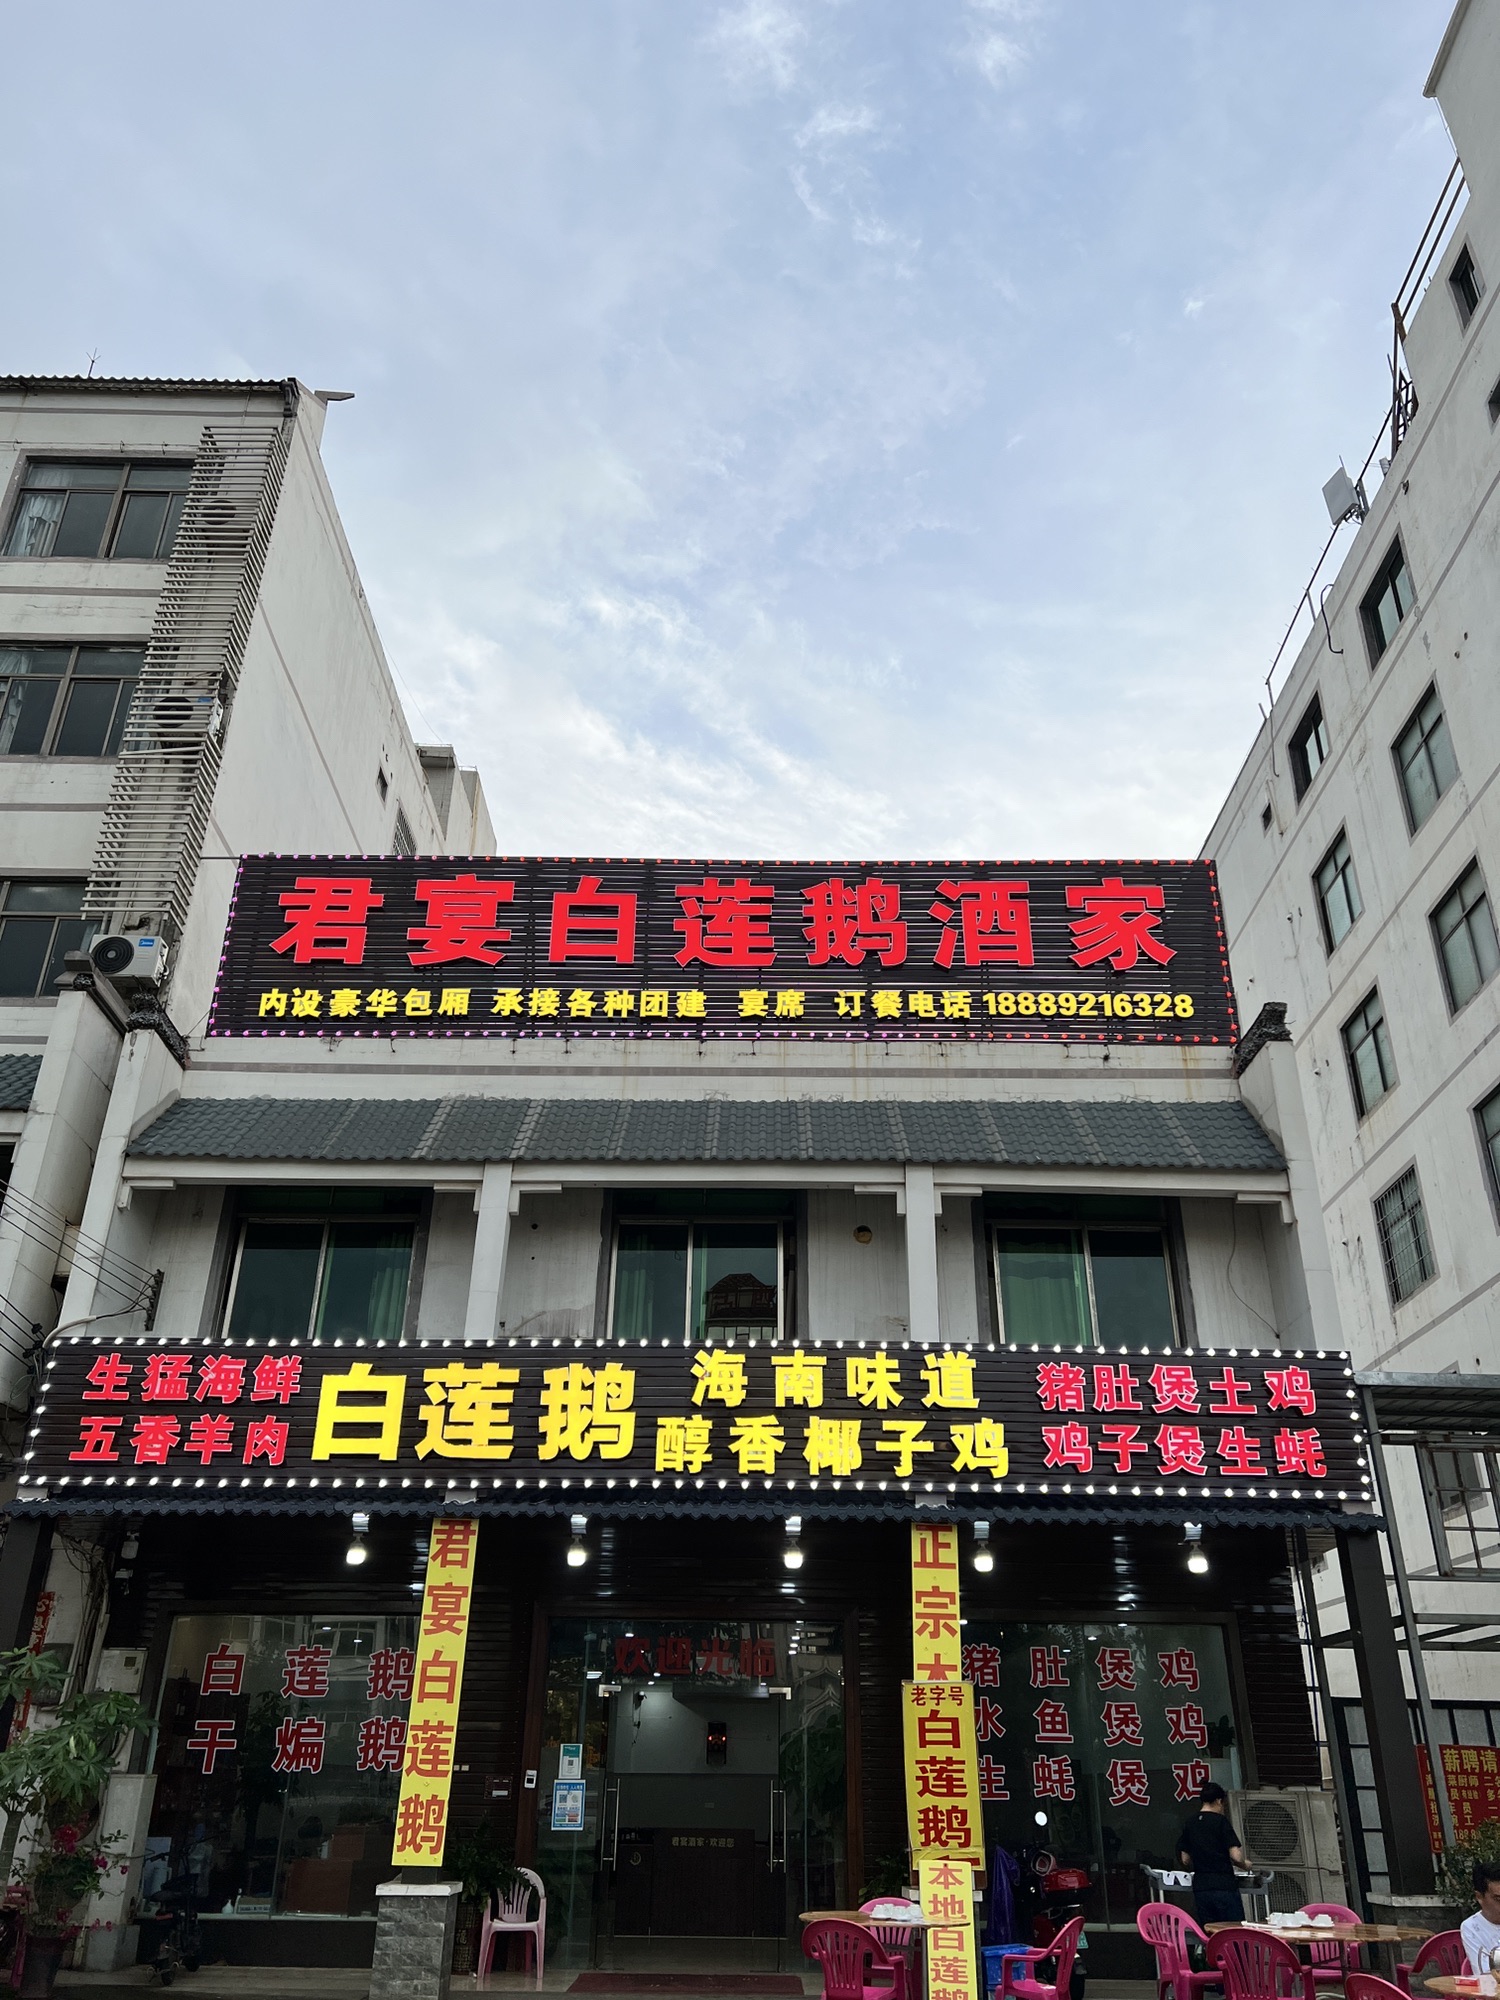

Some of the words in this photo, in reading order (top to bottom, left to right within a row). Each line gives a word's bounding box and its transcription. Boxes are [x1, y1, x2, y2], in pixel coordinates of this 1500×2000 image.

[269, 873, 1176, 971] 君宴白莲鹅酒家
[258, 987, 471, 1018] 内设豪华包厢
[492, 987, 707, 1019] 承接各种团建
[738, 988, 805, 1017] 宴席
[834, 989, 972, 1019] 订餐电话
[982, 991, 1195, 1018] 18889216328
[83, 1353, 302, 1404] 生猛海鲜
[691, 1348, 980, 1410] 海南味道
[1037, 1361, 1317, 1415] 猪肚煲土鸡
[69, 1412, 289, 1466] 五香羊肉
[310, 1362, 637, 1461] 白莲鹅
[655, 1416, 1009, 1478] 醇香椰子鸡
[1042, 1421, 1328, 1478] 鸡子煲生蚝
[200, 1643, 414, 1701] 白莲鹅
[612, 1637, 776, 1678] 欢迎光临
[961, 1643, 1200, 1692] 猪肚煲鸡
[396, 1519, 477, 1856] 君宴白莲鹅
[911, 1685, 965, 1707] 老字号
[187, 1716, 404, 1774] 干煸鹅
[975, 1696, 1209, 1749] 水鱼煲鸡
[915, 1709, 981, 1867] 白莲鹅
[1424, 1748, 1498, 1773] 薪聘请
